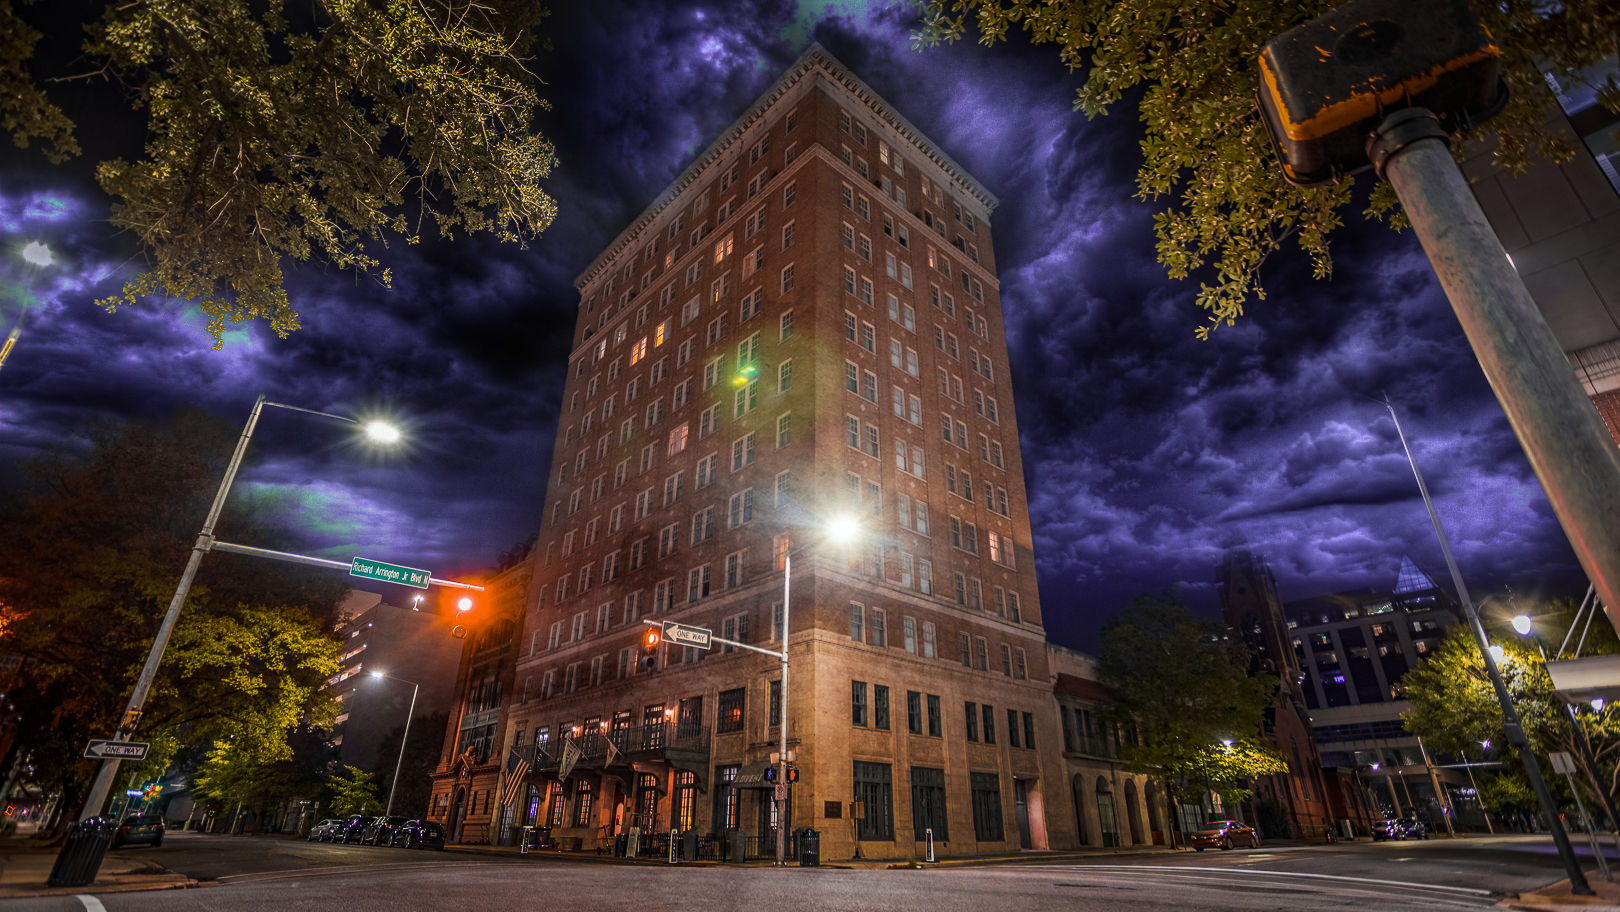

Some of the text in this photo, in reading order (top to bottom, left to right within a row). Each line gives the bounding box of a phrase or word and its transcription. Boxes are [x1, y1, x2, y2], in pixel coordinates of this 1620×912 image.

[353, 562, 428, 584] Richard Arrington Jr Blvd N
[677, 630, 705, 642] ONE WAY
